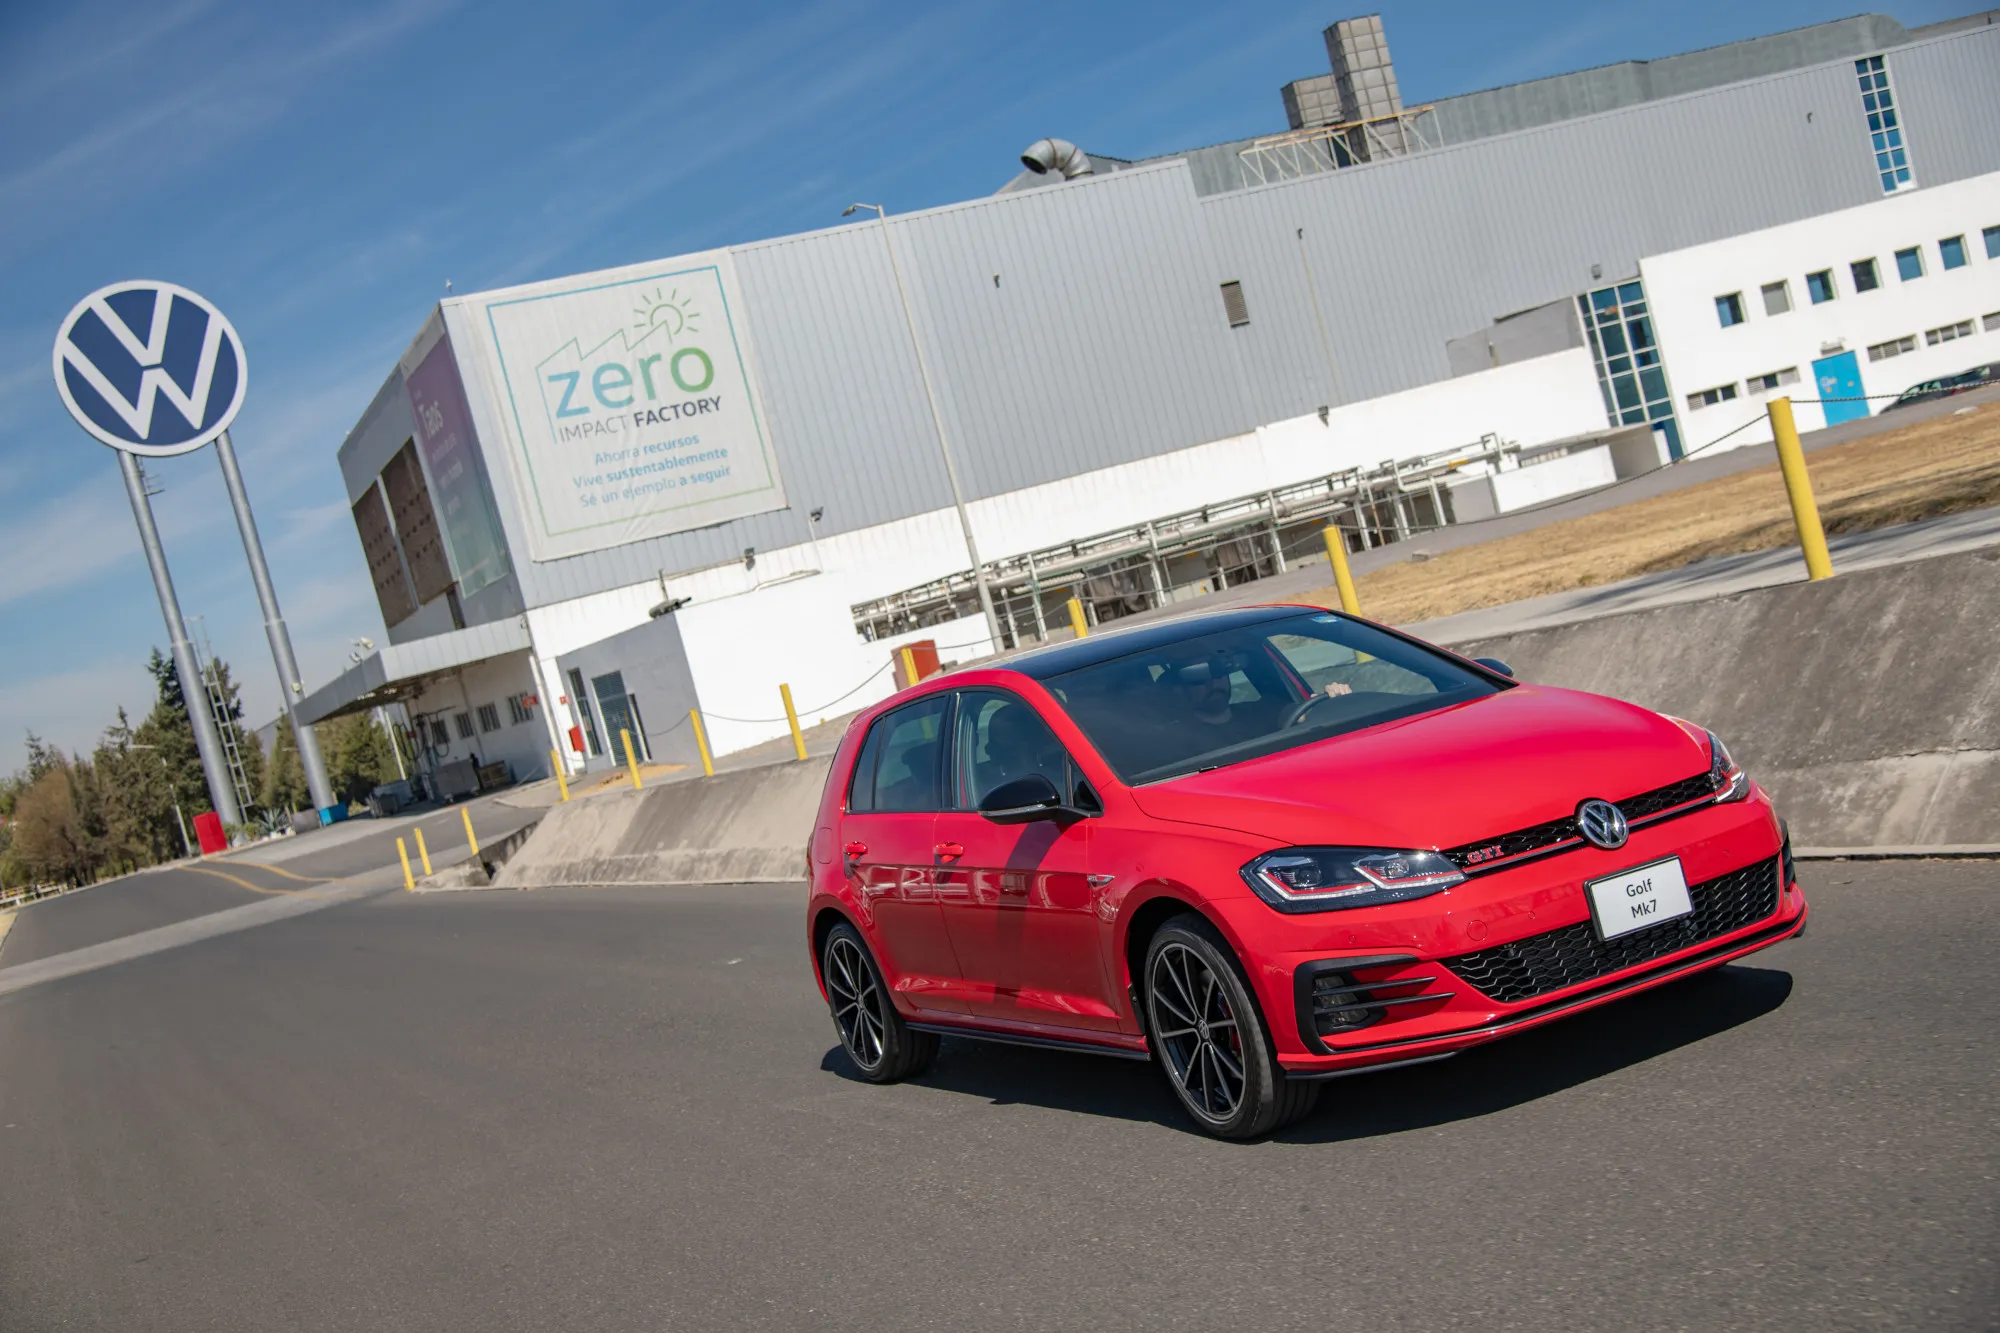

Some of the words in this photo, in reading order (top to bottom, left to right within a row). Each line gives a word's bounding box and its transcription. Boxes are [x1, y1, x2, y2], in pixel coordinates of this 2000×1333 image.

[547, 347, 714, 420] zero
[559, 414, 629, 443] IMPACT
[633, 395, 722, 428] FACTORY
[594, 447, 641, 466] Ahorra
[643, 434, 700, 455] recursos
[572, 474, 604, 489] Vive
[606, 447, 729, 483] sustentablemente
[601, 491, 619, 504] un
[622, 477, 677, 500] ejemplo
[679, 475, 688, 487] a
[690, 465, 731, 484] seguir
[1467, 845, 1504, 863] GTI
[1626, 878, 1653, 898] Golf
[1631, 899, 1657, 919] Mk7
